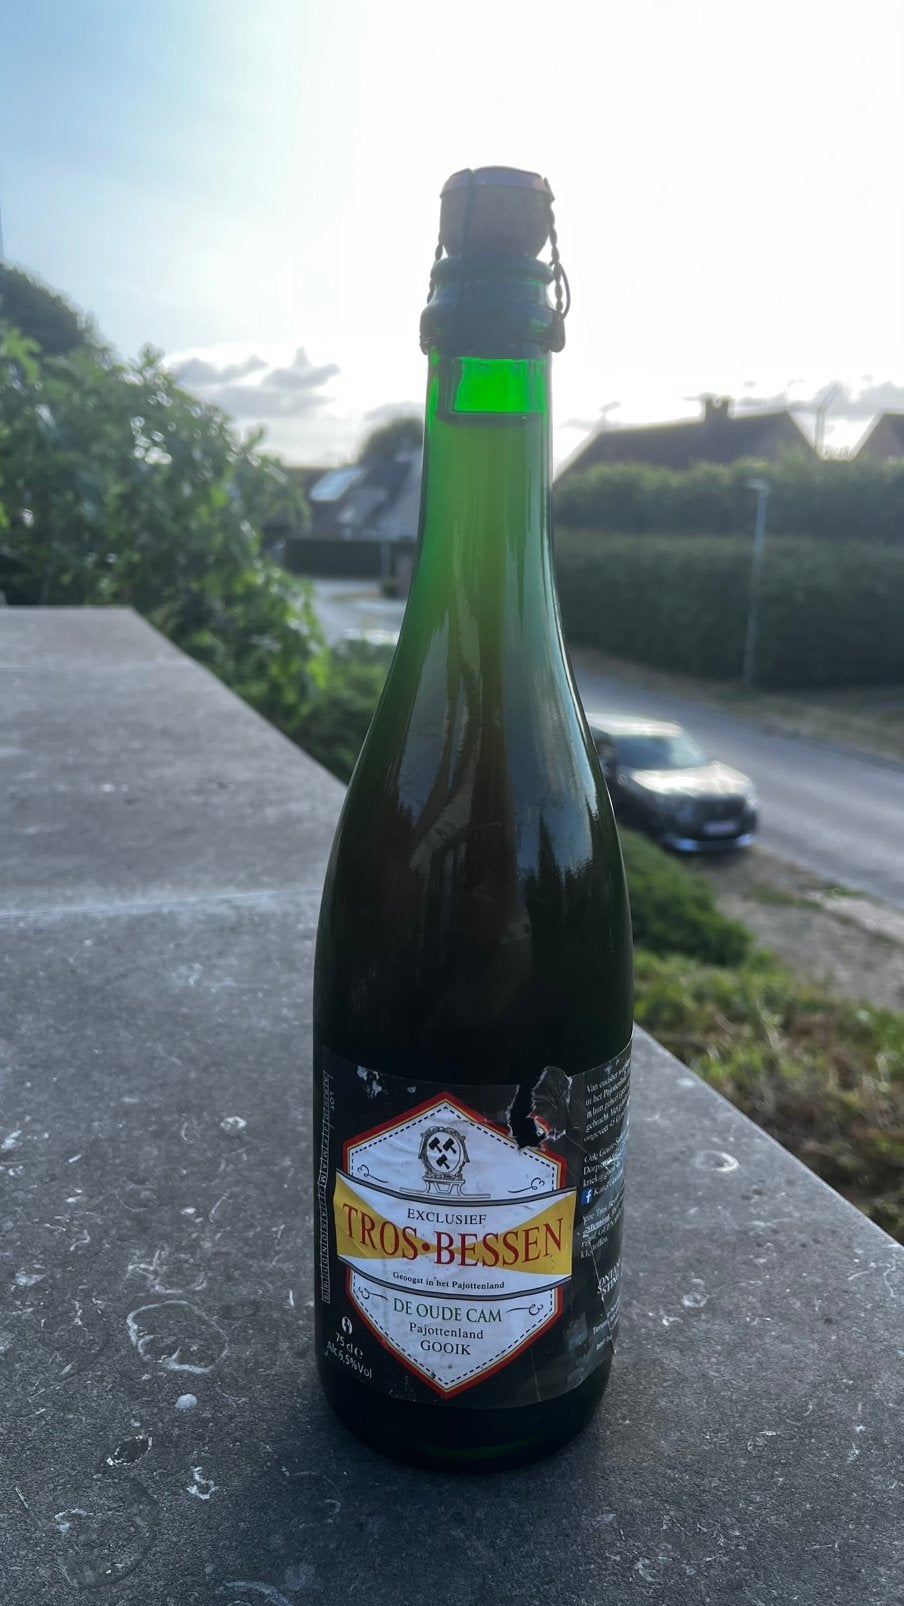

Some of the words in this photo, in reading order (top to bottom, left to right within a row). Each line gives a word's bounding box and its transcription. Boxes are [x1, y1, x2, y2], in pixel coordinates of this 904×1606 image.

[407, 1207, 487, 1225] EXCLUSIEF
[392, 1271, 424, 1285] Geoogst
[425, 1279, 434, 1287] in
[436, 1280, 450, 1289] het
[452, 1280, 506, 1291] Pajottenland
[393, 1297, 413, 1316] DE
[416, 1303, 462, 1321] OUDE
[466, 1308, 503, 1323] CAM
[335, 1331, 345, 1347] 75
[409, 1321, 485, 1340] Pajottenland
[420, 1339, 472, 1356] GOOIK
